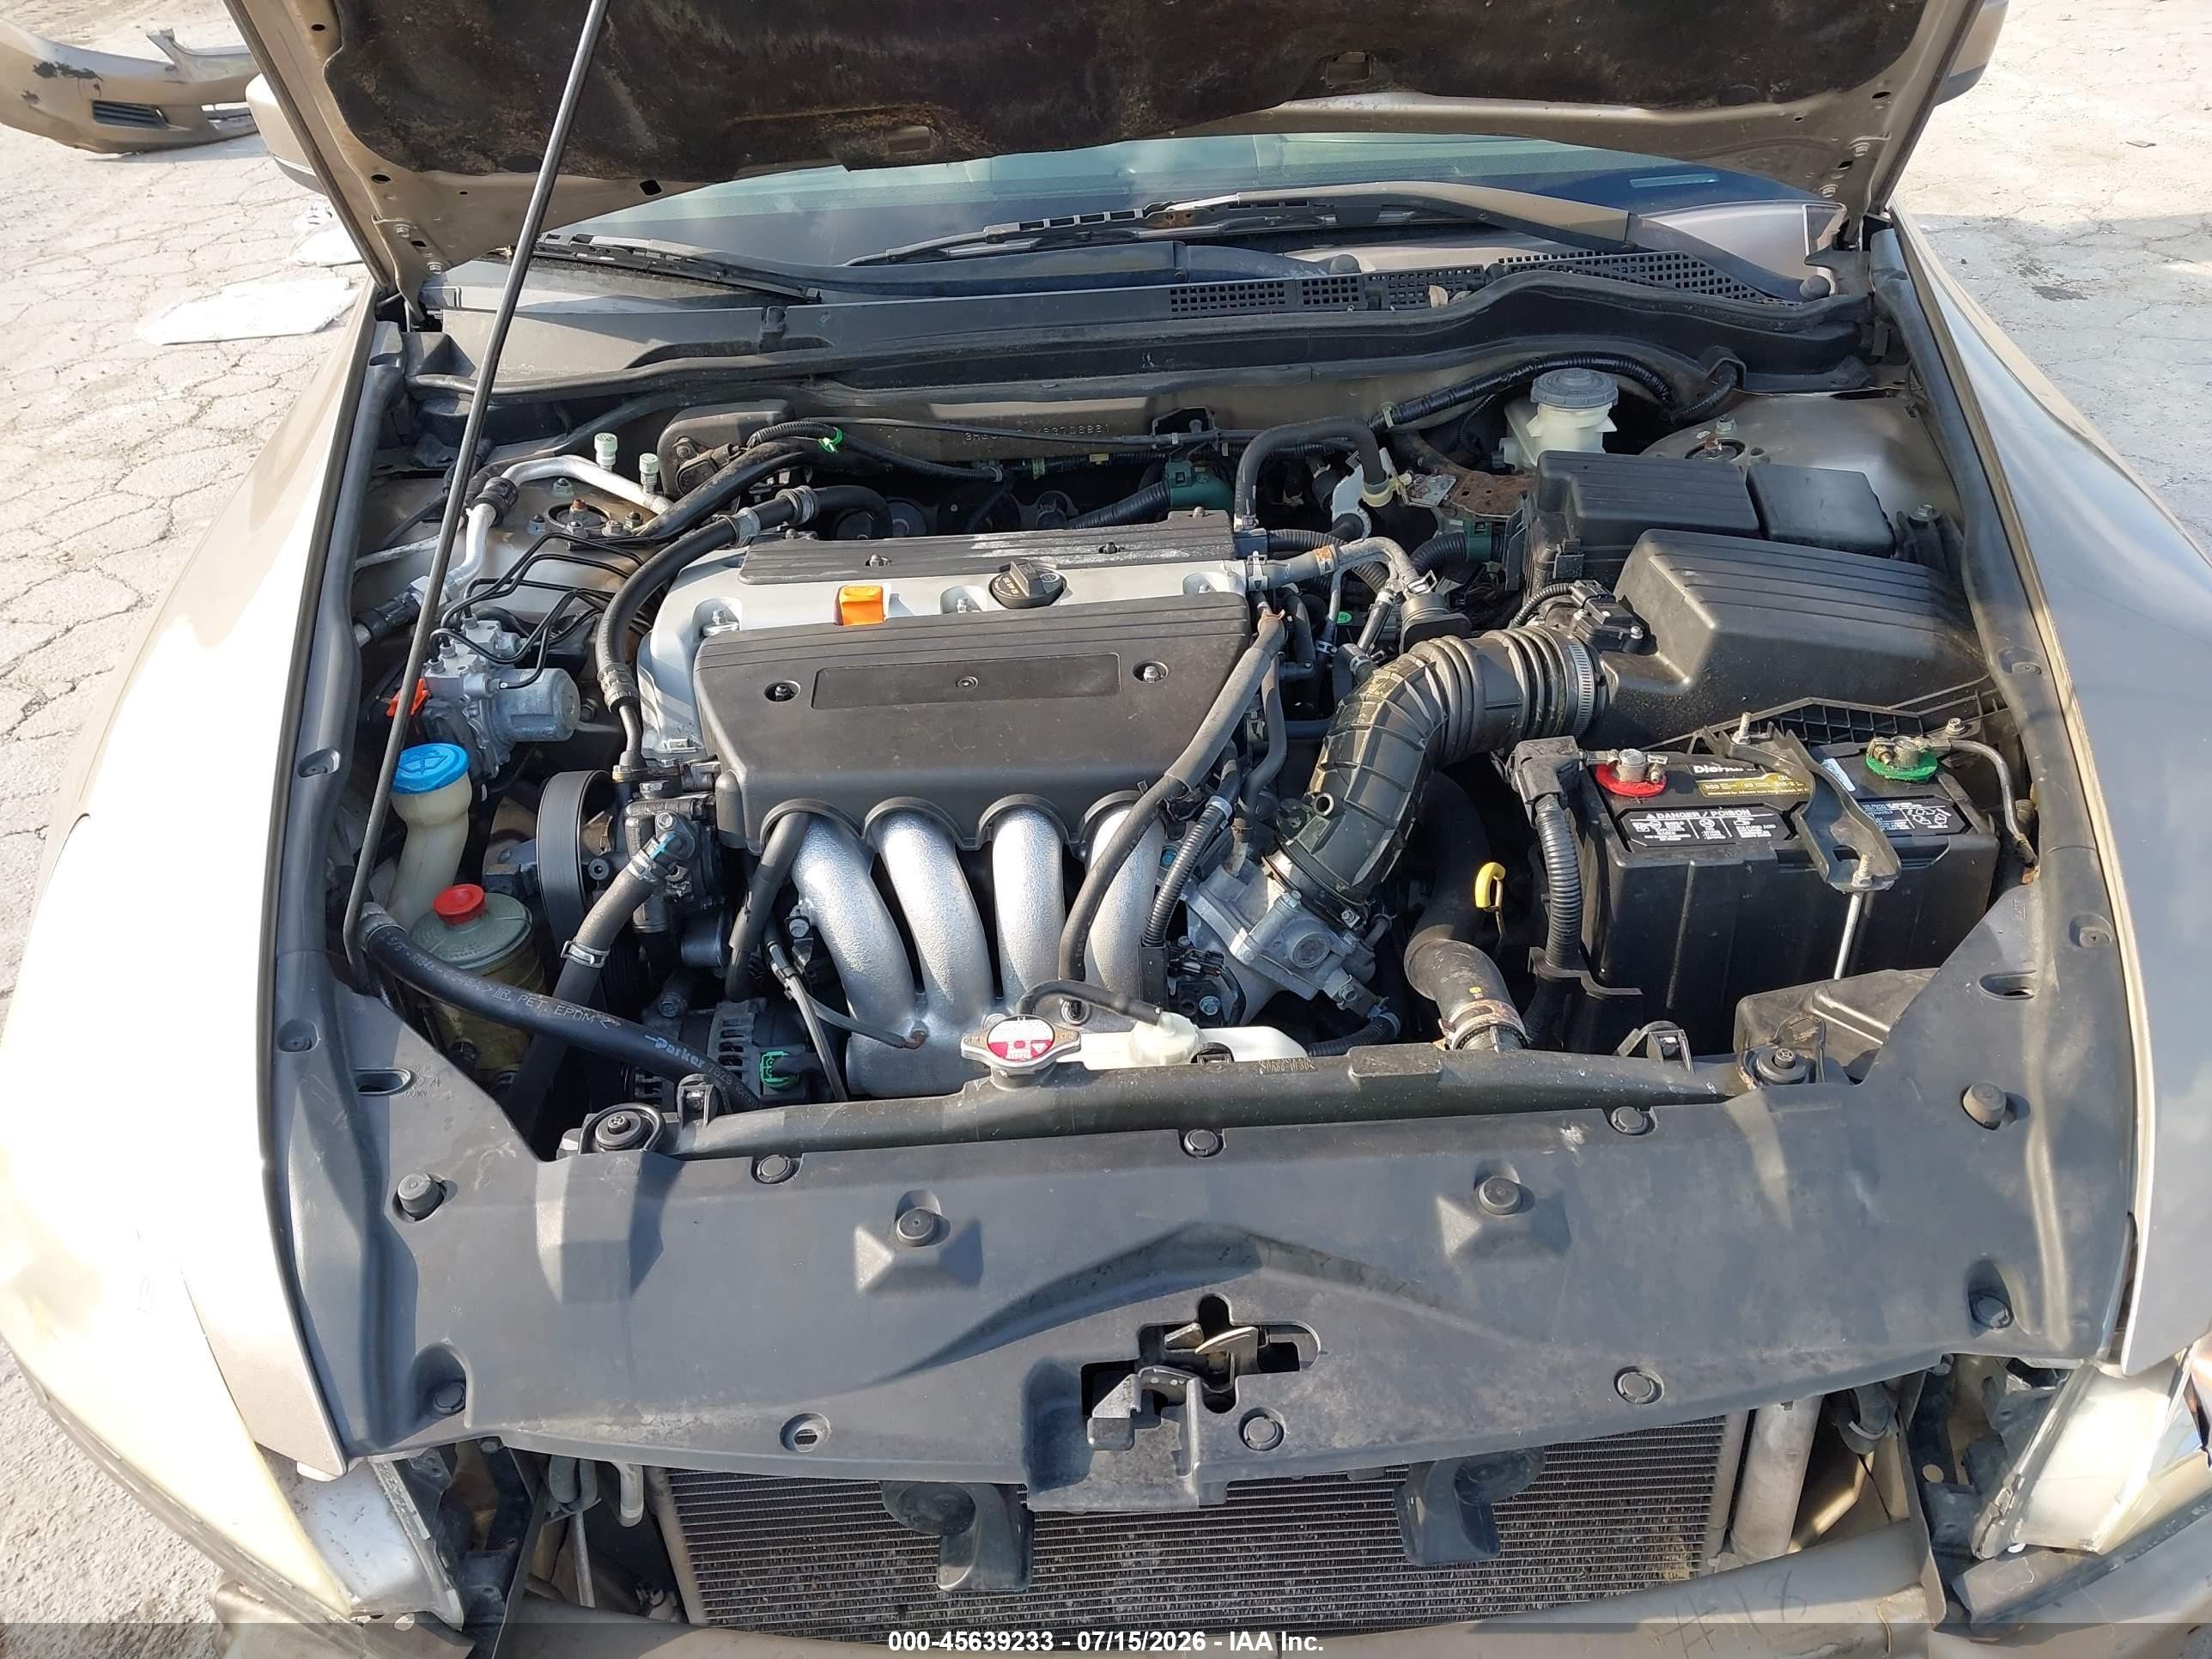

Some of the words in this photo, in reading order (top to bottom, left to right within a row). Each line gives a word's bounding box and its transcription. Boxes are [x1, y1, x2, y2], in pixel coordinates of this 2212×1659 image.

[1656, 811, 1700, 820] DANGER
[1710, 809, 1752, 818] POISON
[654, 1036, 706, 1069] Parker
